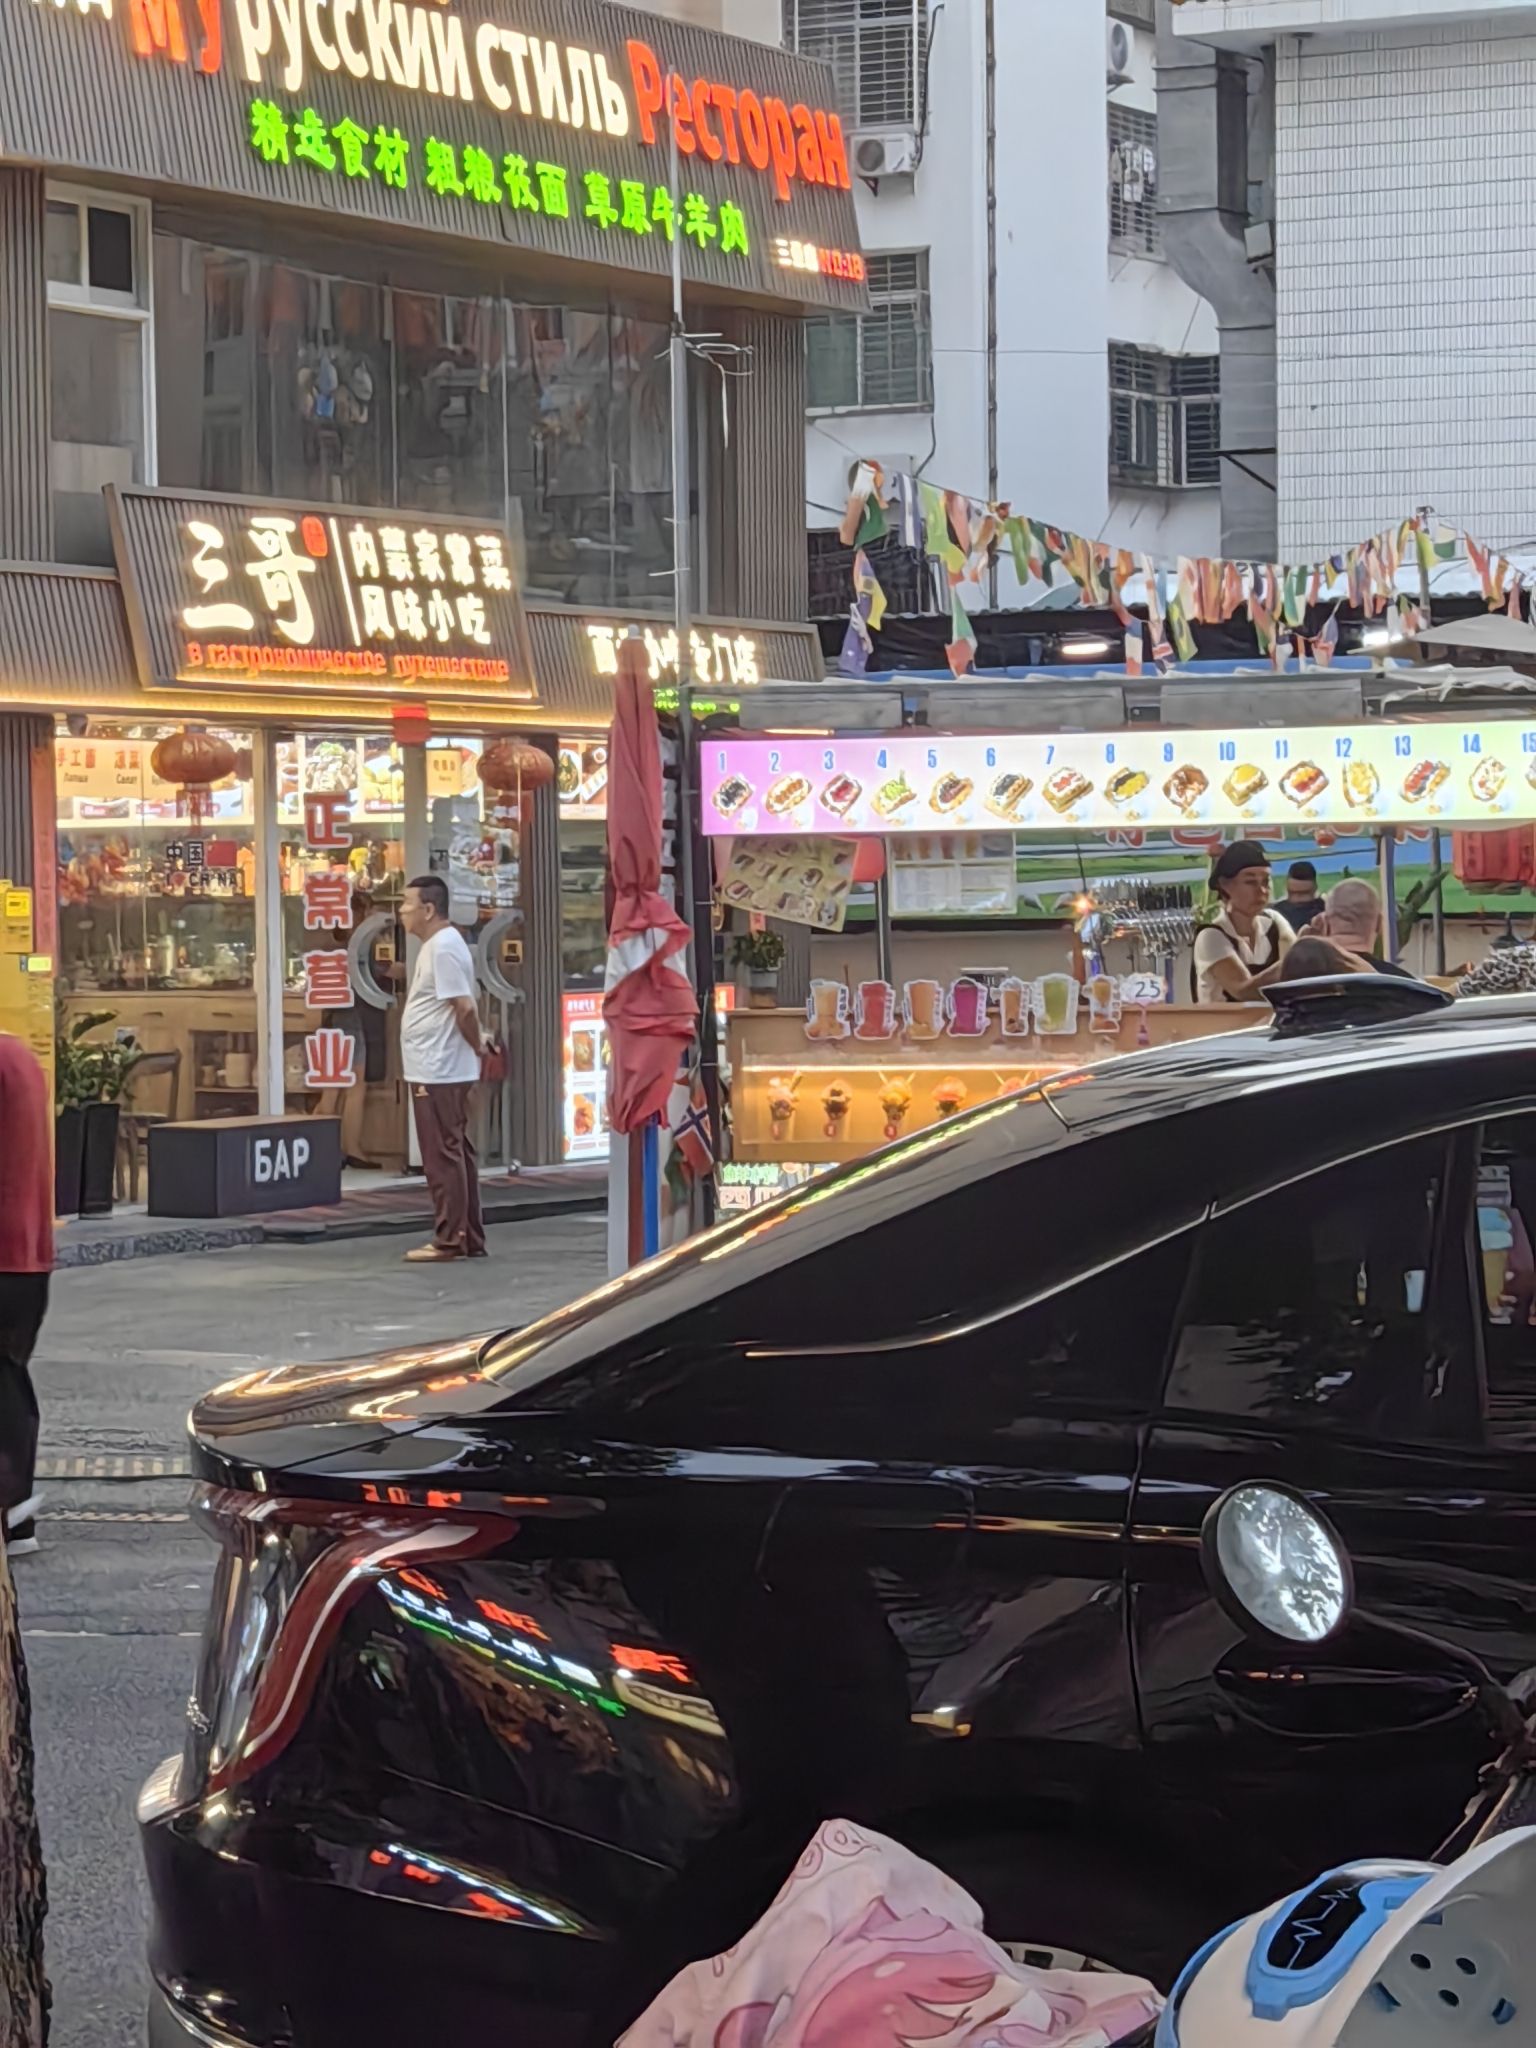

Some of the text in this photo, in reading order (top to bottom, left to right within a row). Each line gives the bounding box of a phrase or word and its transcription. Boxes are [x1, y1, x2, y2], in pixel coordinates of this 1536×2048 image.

[476, 22, 630, 138] стиль
[626, 38, 852, 203] Ресторан
[251, 98, 410, 189] 精选食材
[583, 169, 750, 257] 草原牛羊肉
[182, 516, 317, 646] 三哥
[359, 585, 491, 646] 风味小吃
[1163, 742, 1174, 762] 9
[1219, 741, 1236, 761] 10
[1275, 739, 1289, 759] 11
[1335, 737, 1353, 758] 12
[1394, 735, 1411, 756] 13
[1463, 733, 1482, 754] 14
[1521, 732, 1536, 753] 15
[719, 752, 726, 772] 1
[770, 752, 779, 772] 2
[824, 750, 834, 770] 3
[877, 749, 887, 769] 4
[927, 749, 937, 768] 5
[986, 747, 996, 767] 6
[1046, 745, 1055, 765] 7
[1105, 743, 1115, 764] 8
[166, 840, 204, 867] 中国
[303, 790, 357, 1088] 正常营业
[1134, 980, 1162, 999] 25
[253, 1137, 310, 1183] БАР
